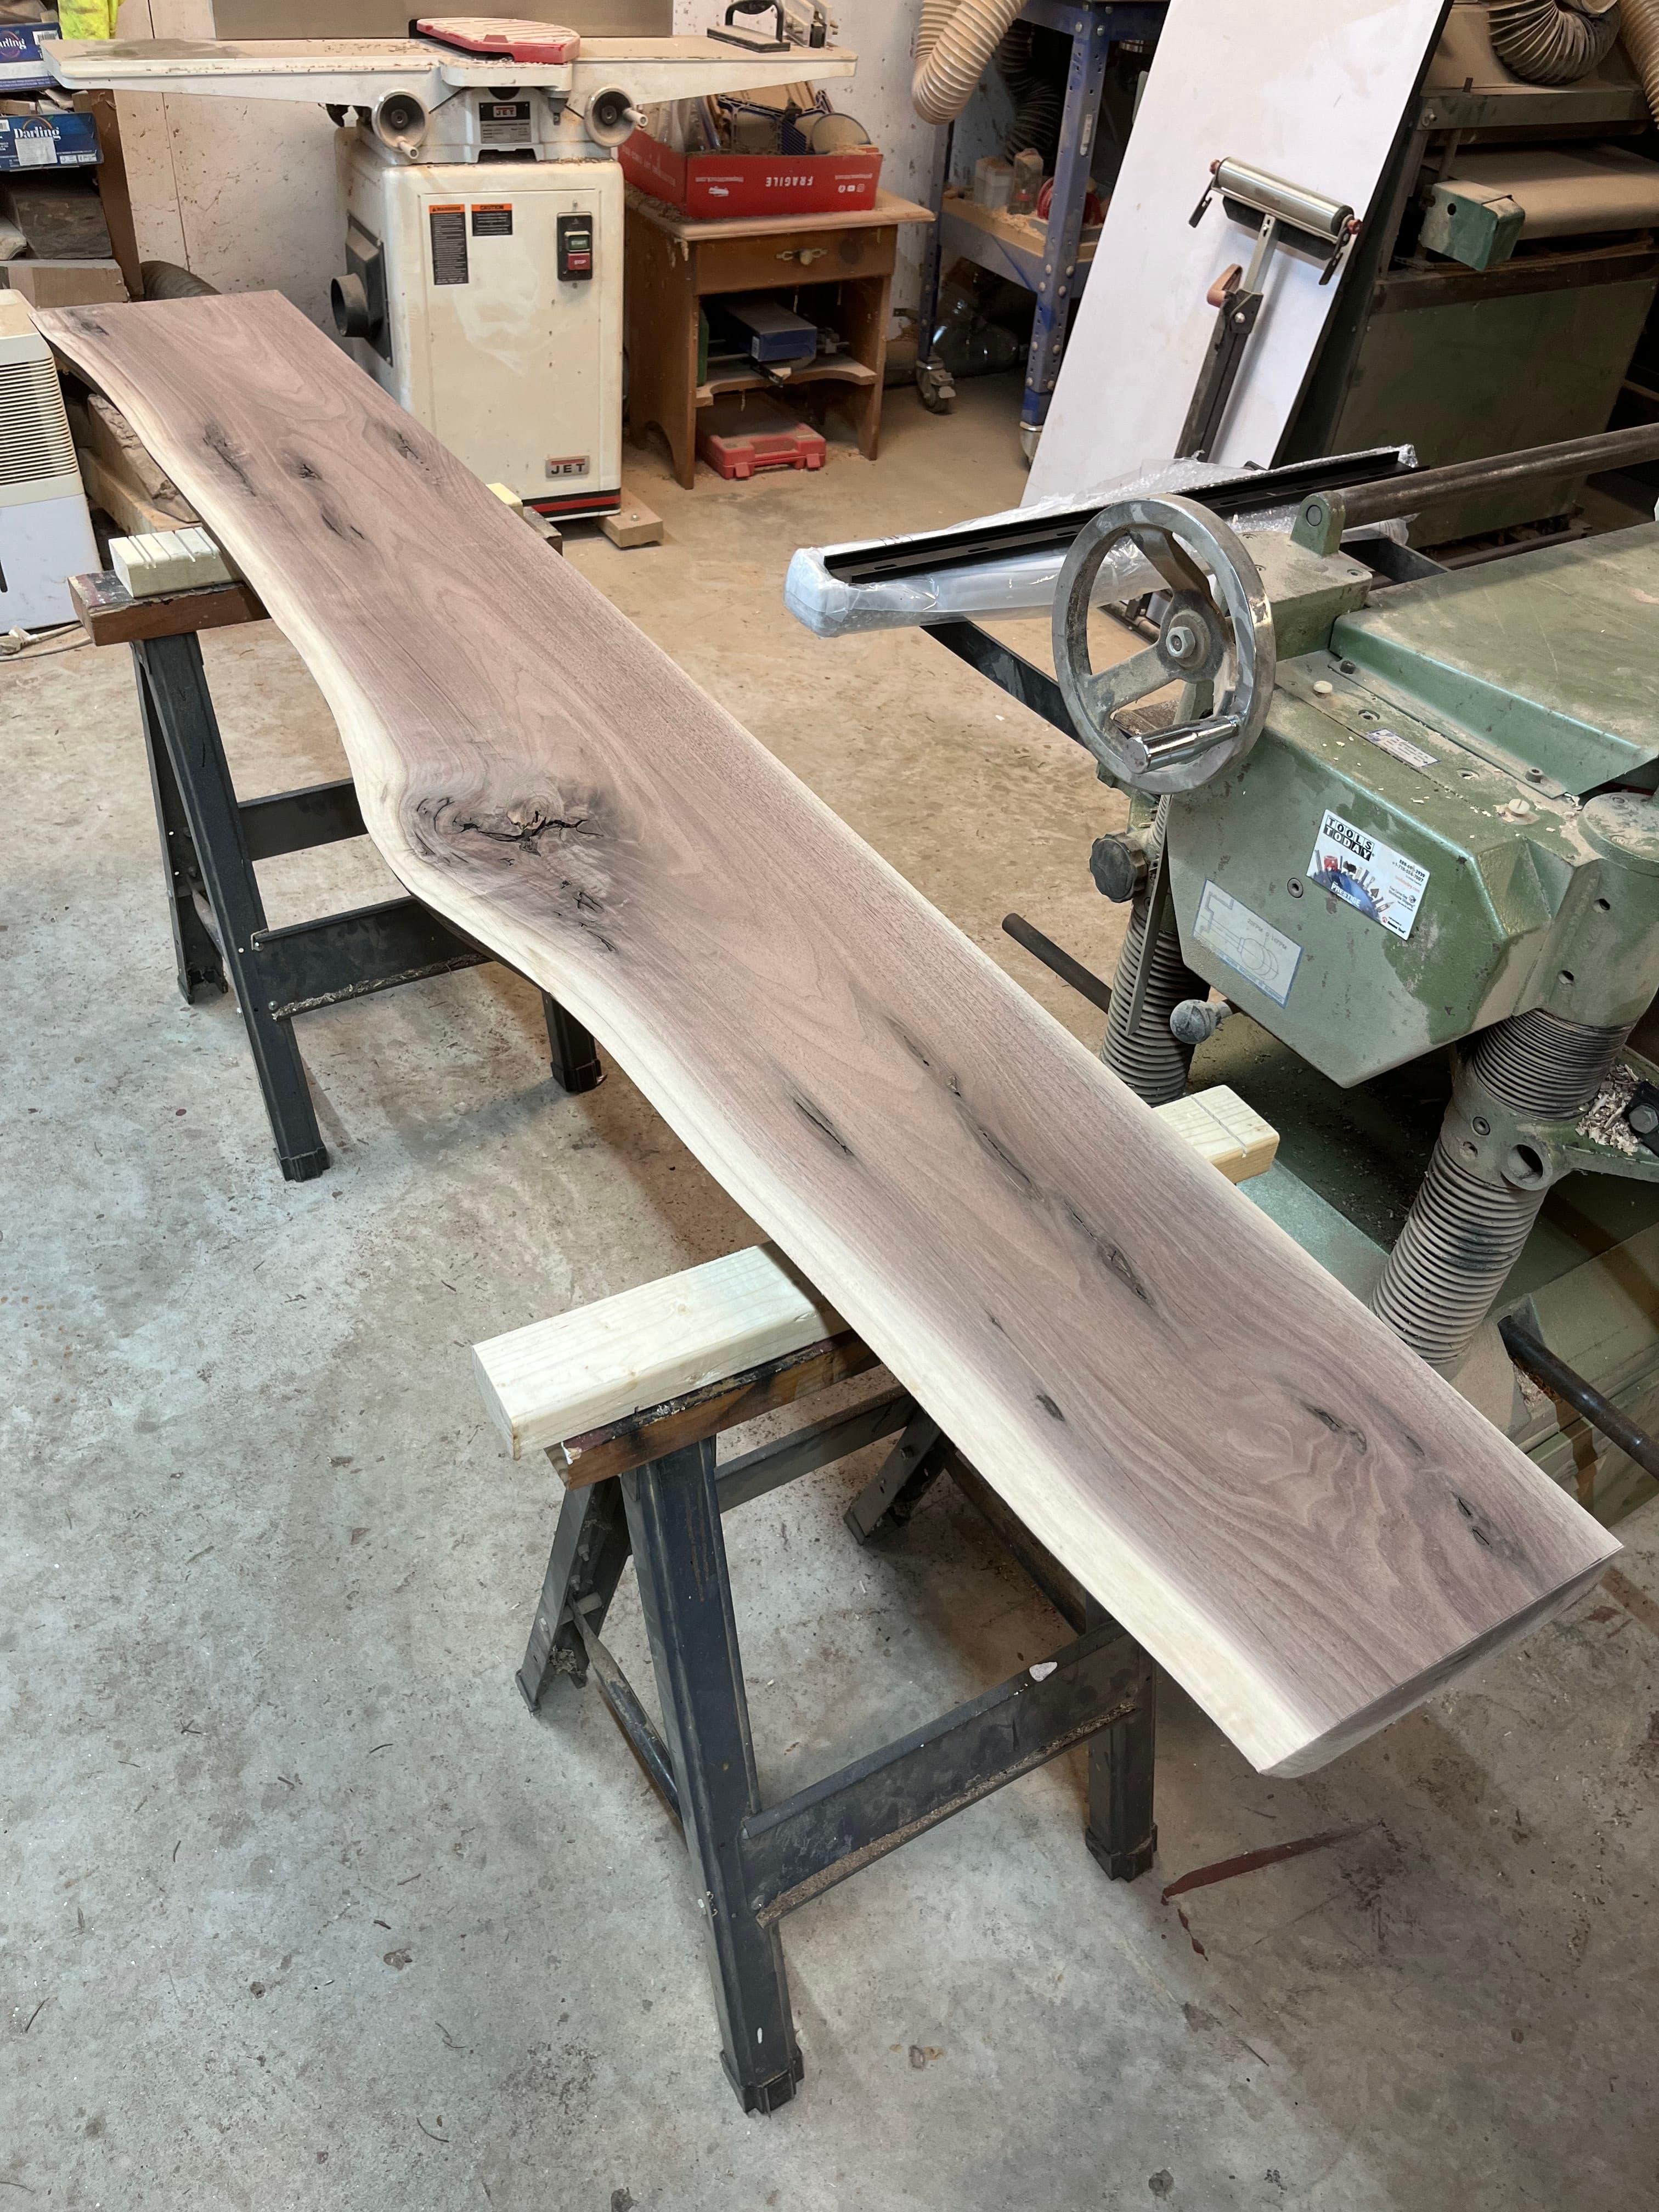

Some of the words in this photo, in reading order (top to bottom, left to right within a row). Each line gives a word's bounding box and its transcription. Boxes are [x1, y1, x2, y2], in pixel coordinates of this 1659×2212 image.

[14, 126, 61, 142] Darling
[765, 176, 814, 187] FRAGILE
[551, 463, 585, 475] JET
[1325, 825, 1370, 860] TODAY
[1328, 816, 1373, 850] TOOLS
[1331, 882, 1361, 907] PRESTIGE
